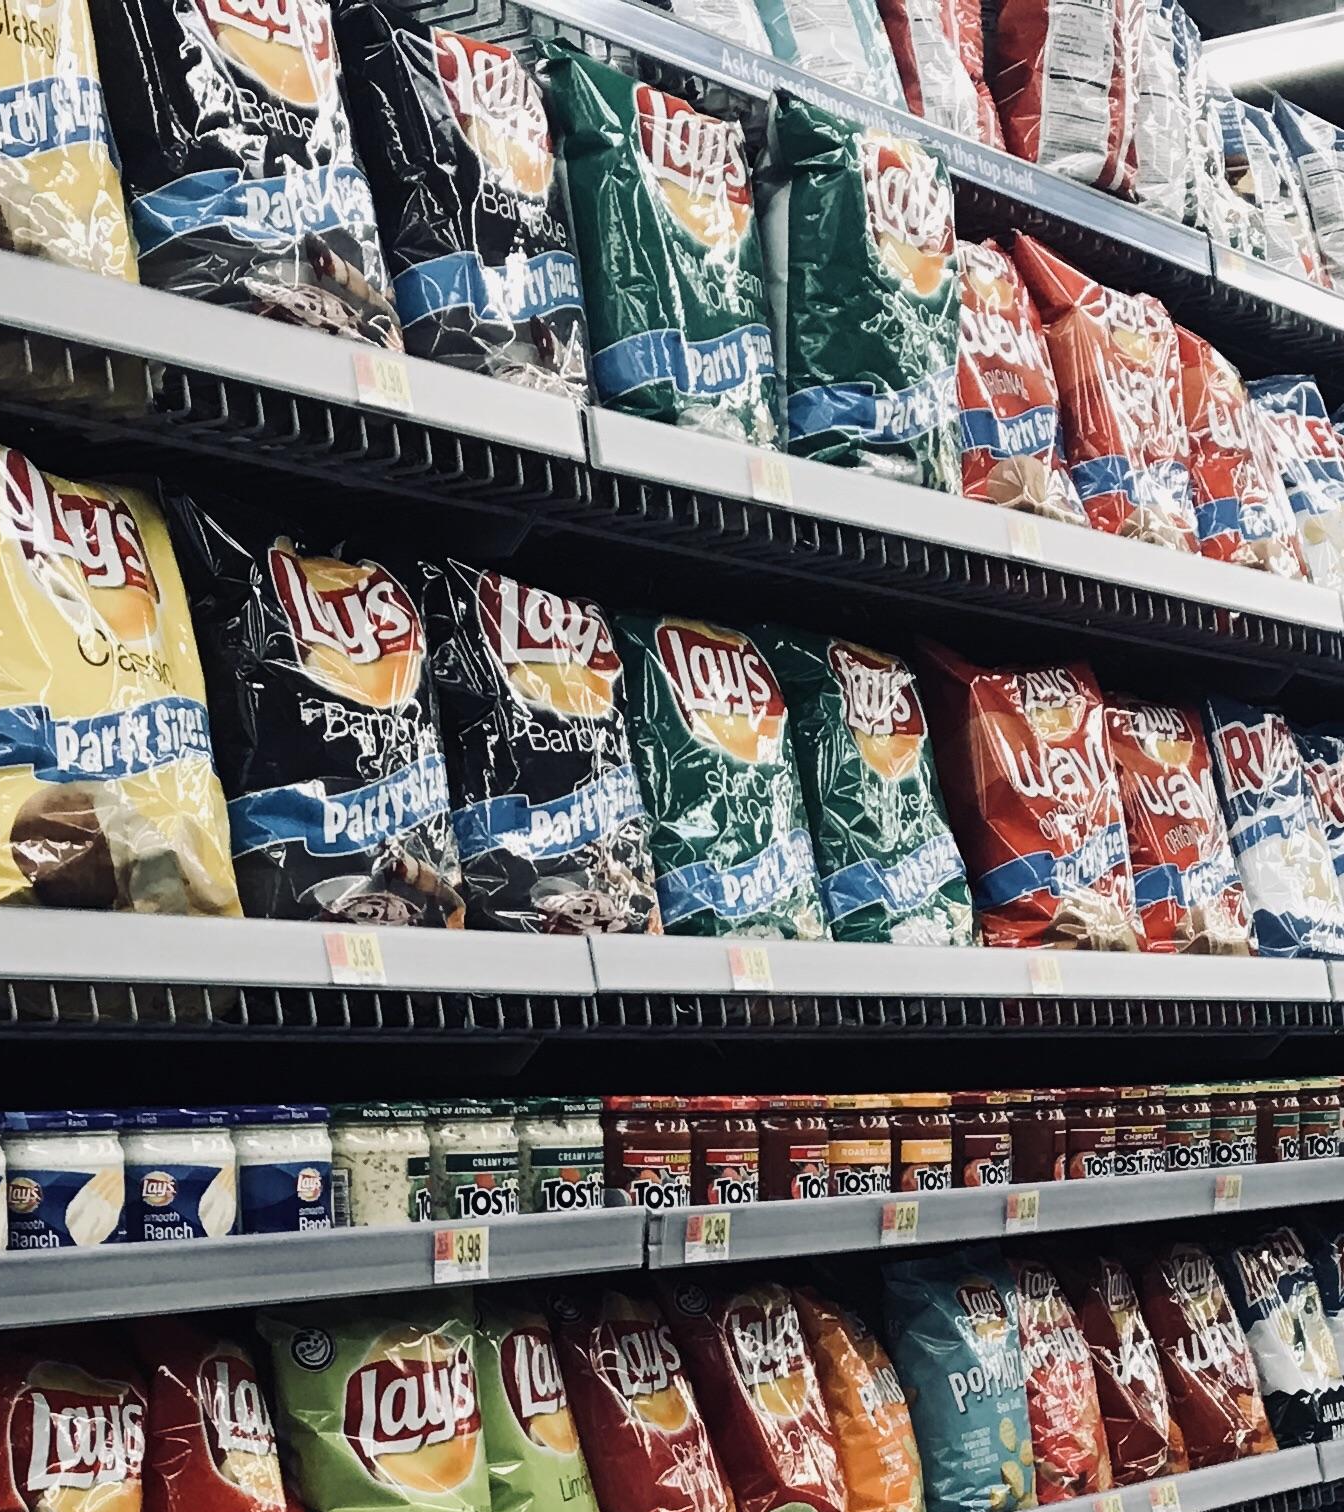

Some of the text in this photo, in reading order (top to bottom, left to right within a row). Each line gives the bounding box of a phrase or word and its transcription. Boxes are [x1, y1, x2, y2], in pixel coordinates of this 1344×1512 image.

[721, 49, 750, 78] Ask
[751, 59, 774, 87] for
[858, 102, 888, 130] with
[953, 141, 975, 167] the
[977, 154, 1001, 183] top
[1004, 164, 1037, 194] shelf.
[56, 714, 149, 775] Party
[323, 782, 406, 843] Party
[144, 1212, 180, 1223] smooth
[145, 1223, 193, 1239] Ranch
[11, 1231, 59, 1248] Ranch
